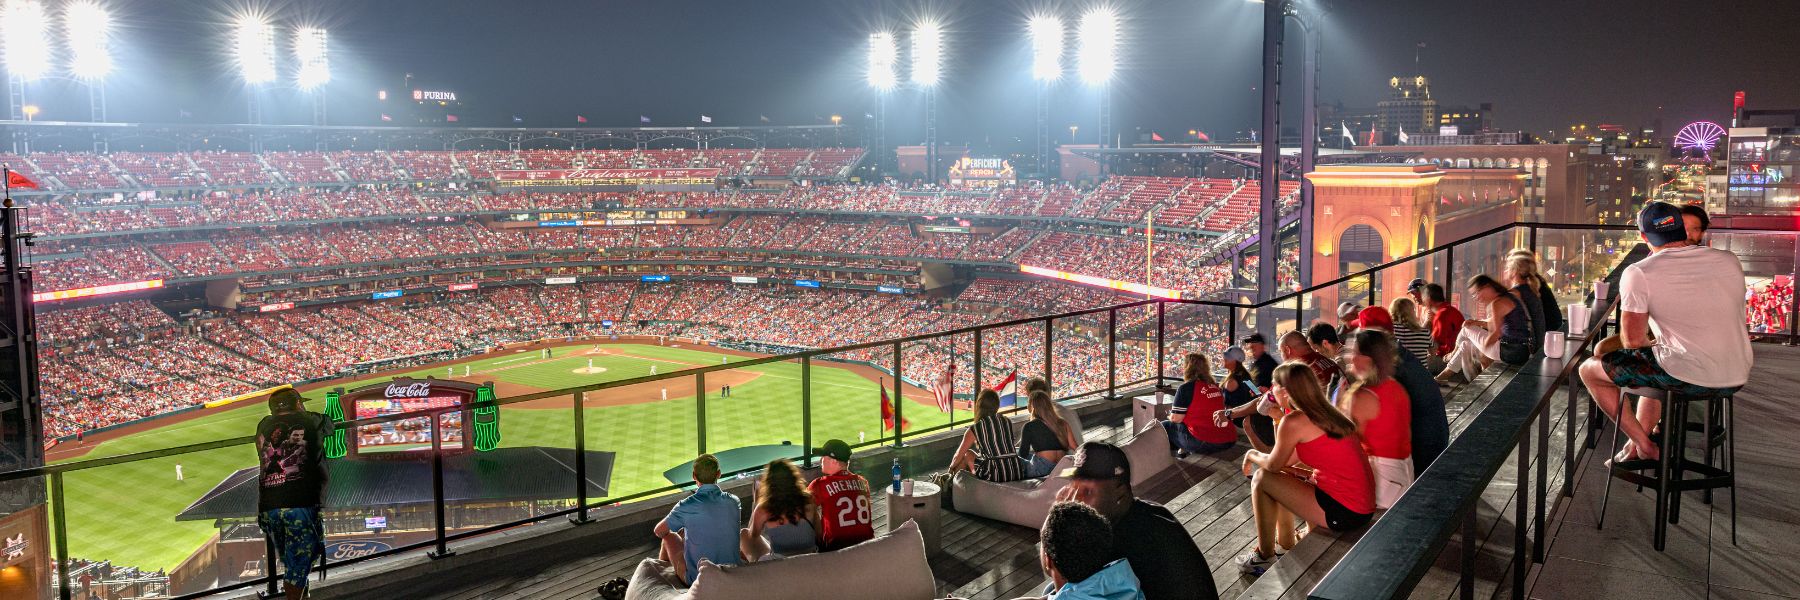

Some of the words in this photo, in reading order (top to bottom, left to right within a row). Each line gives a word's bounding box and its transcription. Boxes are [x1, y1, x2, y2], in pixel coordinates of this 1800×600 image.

[424, 91, 456, 100] PURINA
[962, 157, 1001, 169] PERFICIENT
[565, 169, 653, 179] Budweiser
[384, 382, 431, 398] Coca-Cola
[836, 495, 870, 527] 28
[334, 543, 377, 559] Ford
